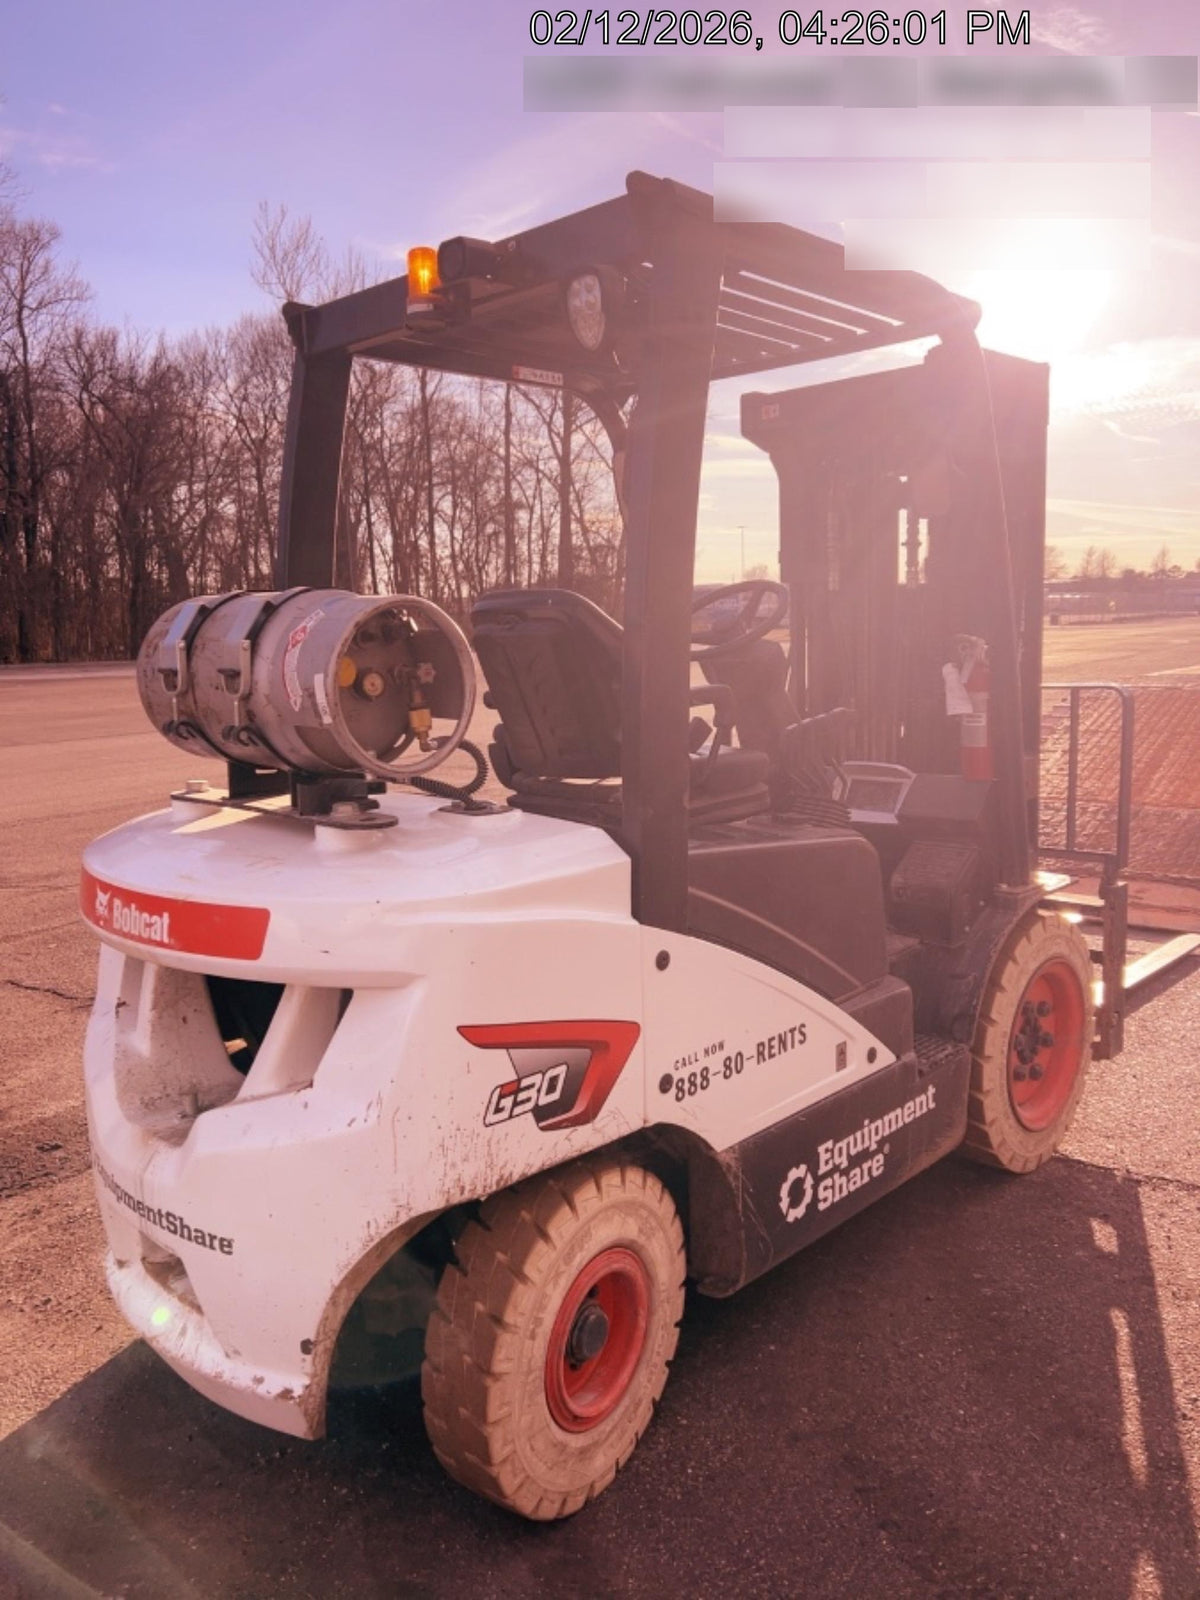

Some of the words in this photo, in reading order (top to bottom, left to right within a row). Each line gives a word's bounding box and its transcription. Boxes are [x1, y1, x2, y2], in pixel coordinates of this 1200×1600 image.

[112, 897, 170, 943] Bobcat
[674, 1051, 699, 1071] CALL
[703, 1039, 725, 1058] NOW
[674, 1023, 807, 1102] 888-80-RENTS
[483, 1062, 569, 1127] G30
[817, 1084, 936, 1176] Equipment
[817, 1153, 884, 1211] Share
